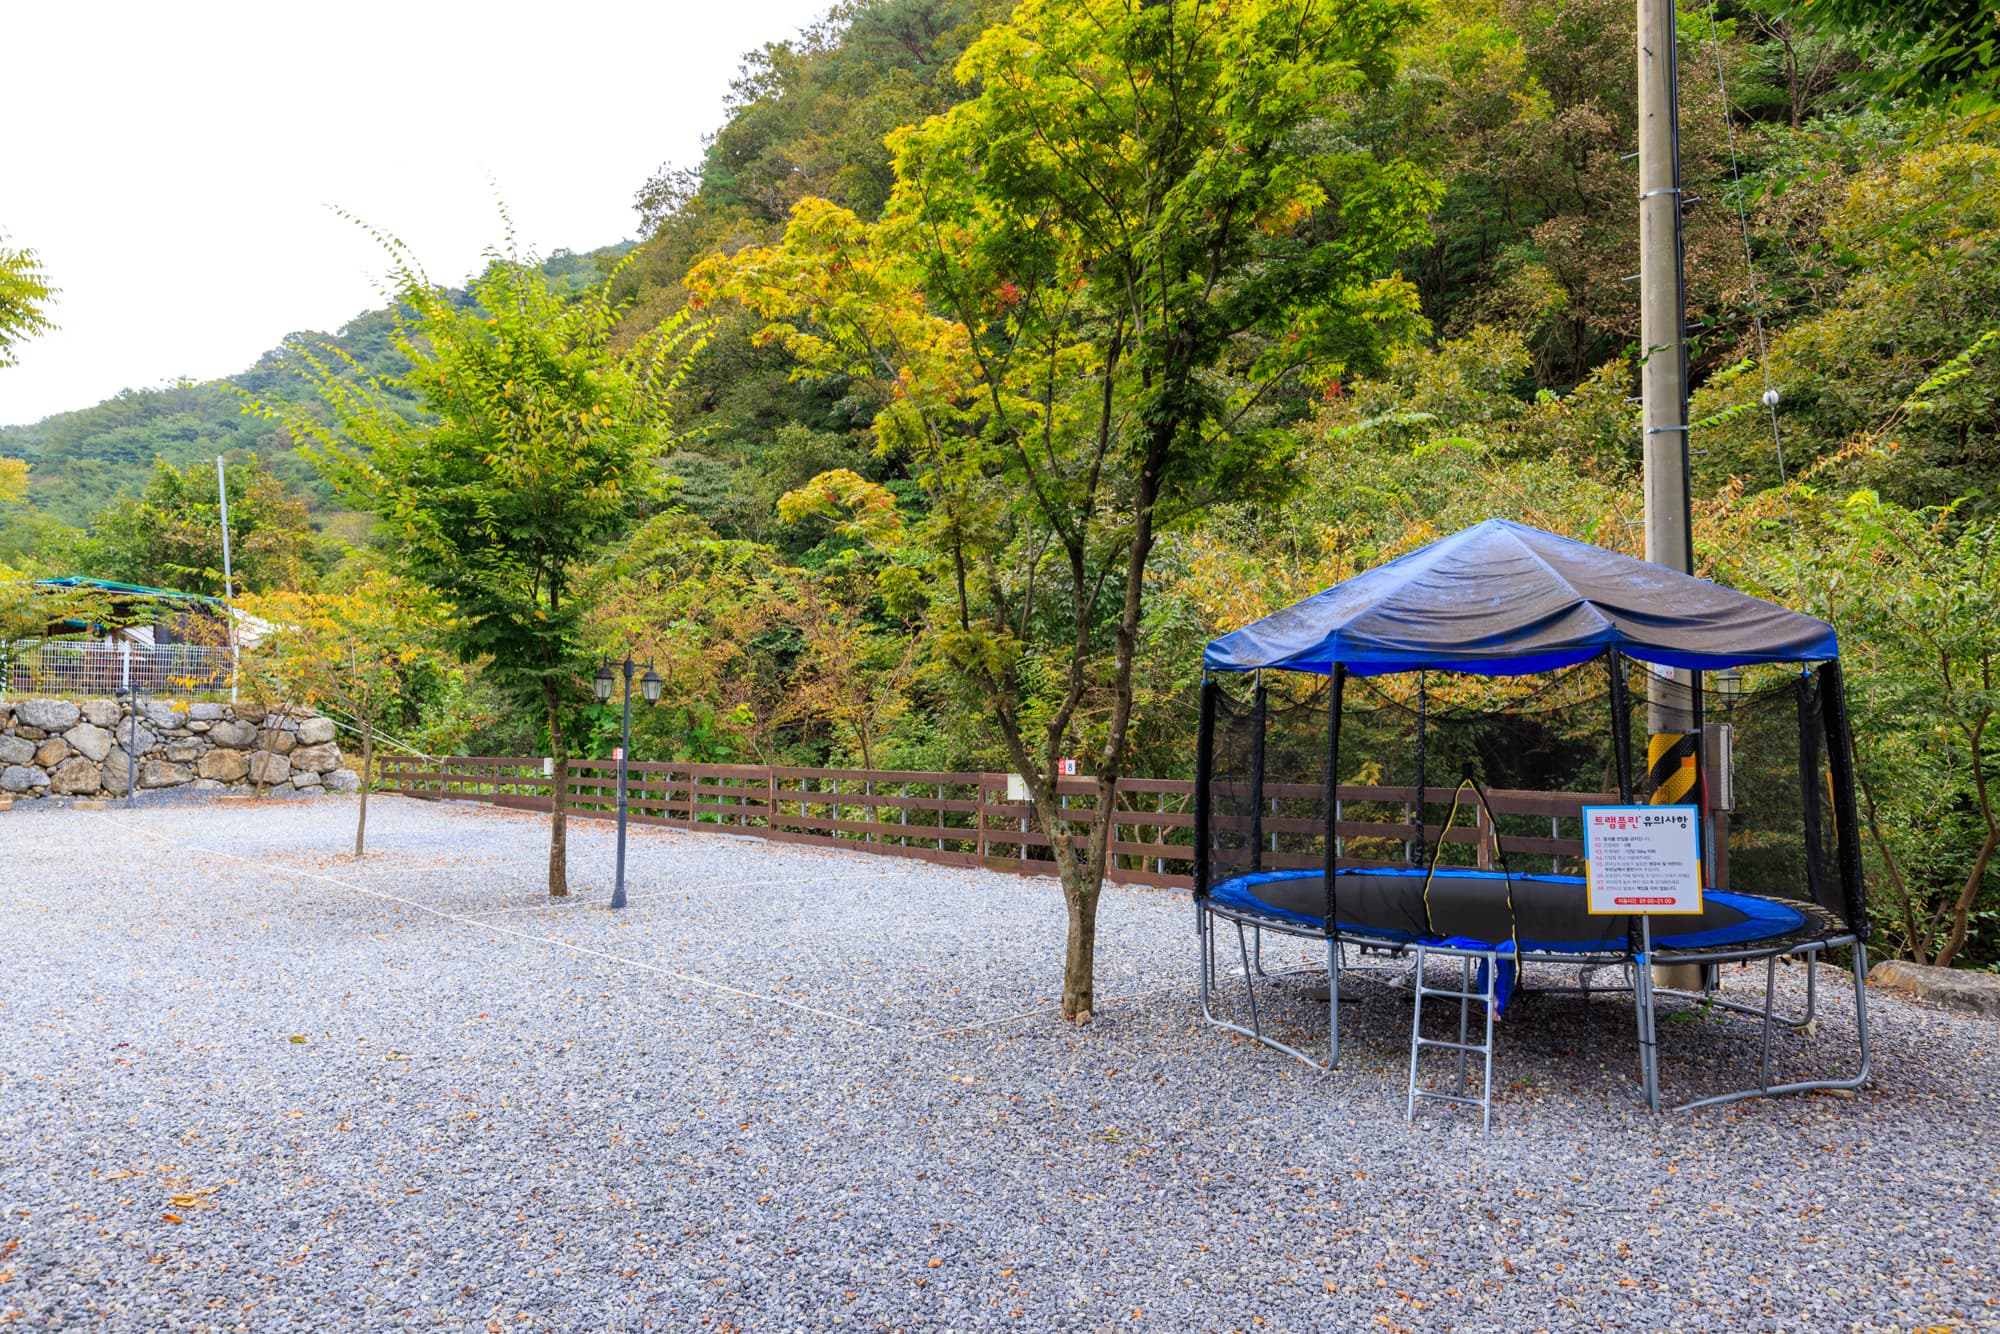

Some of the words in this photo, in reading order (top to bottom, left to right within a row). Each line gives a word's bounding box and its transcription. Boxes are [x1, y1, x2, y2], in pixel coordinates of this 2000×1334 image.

[1067, 762, 1073, 772] 8
[1594, 816, 1639, 829] 트램플린
[1643, 816, 1688, 829] 유의사항
